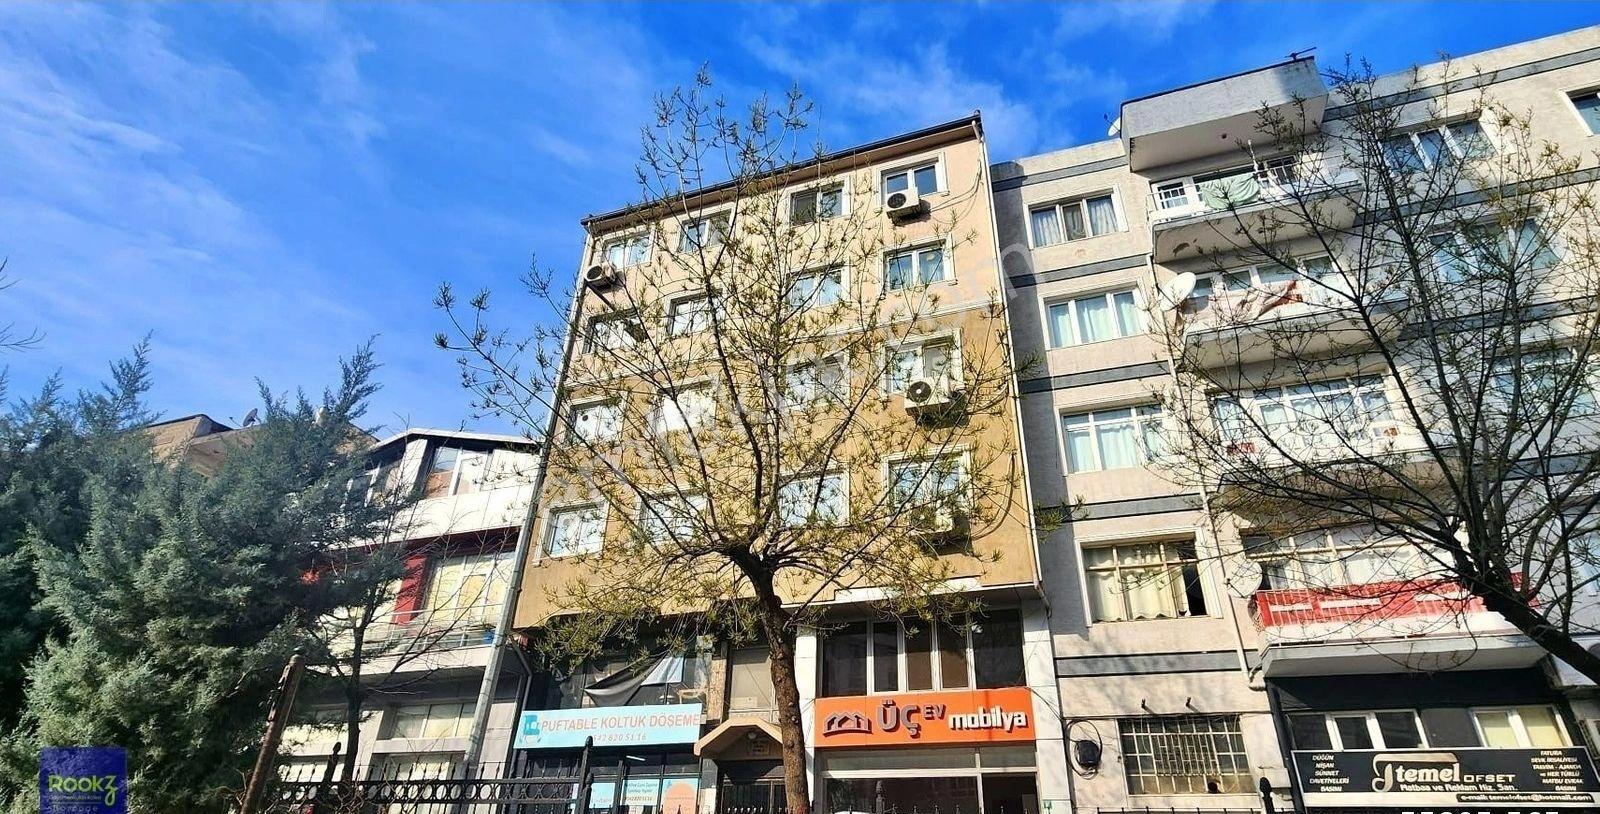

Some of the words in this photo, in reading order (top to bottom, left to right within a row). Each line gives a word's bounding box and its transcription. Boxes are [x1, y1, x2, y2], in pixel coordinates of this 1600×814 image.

[542, 717, 598, 732] PUFTABLE
[601, 715, 646, 730] KOLTUK
[877, 699, 920, 737] ÜÇ
[923, 704, 946, 720] EV
[948, 705, 1028, 732] mobilya
[1396, 763, 1460, 782] temel
[1463, 774, 1516, 783] OFSET
[1400, 784, 1431, 792] Matbaa
[1445, 784, 1478, 792] Reklam
[1479, 784, 1496, 792] Hiz.
